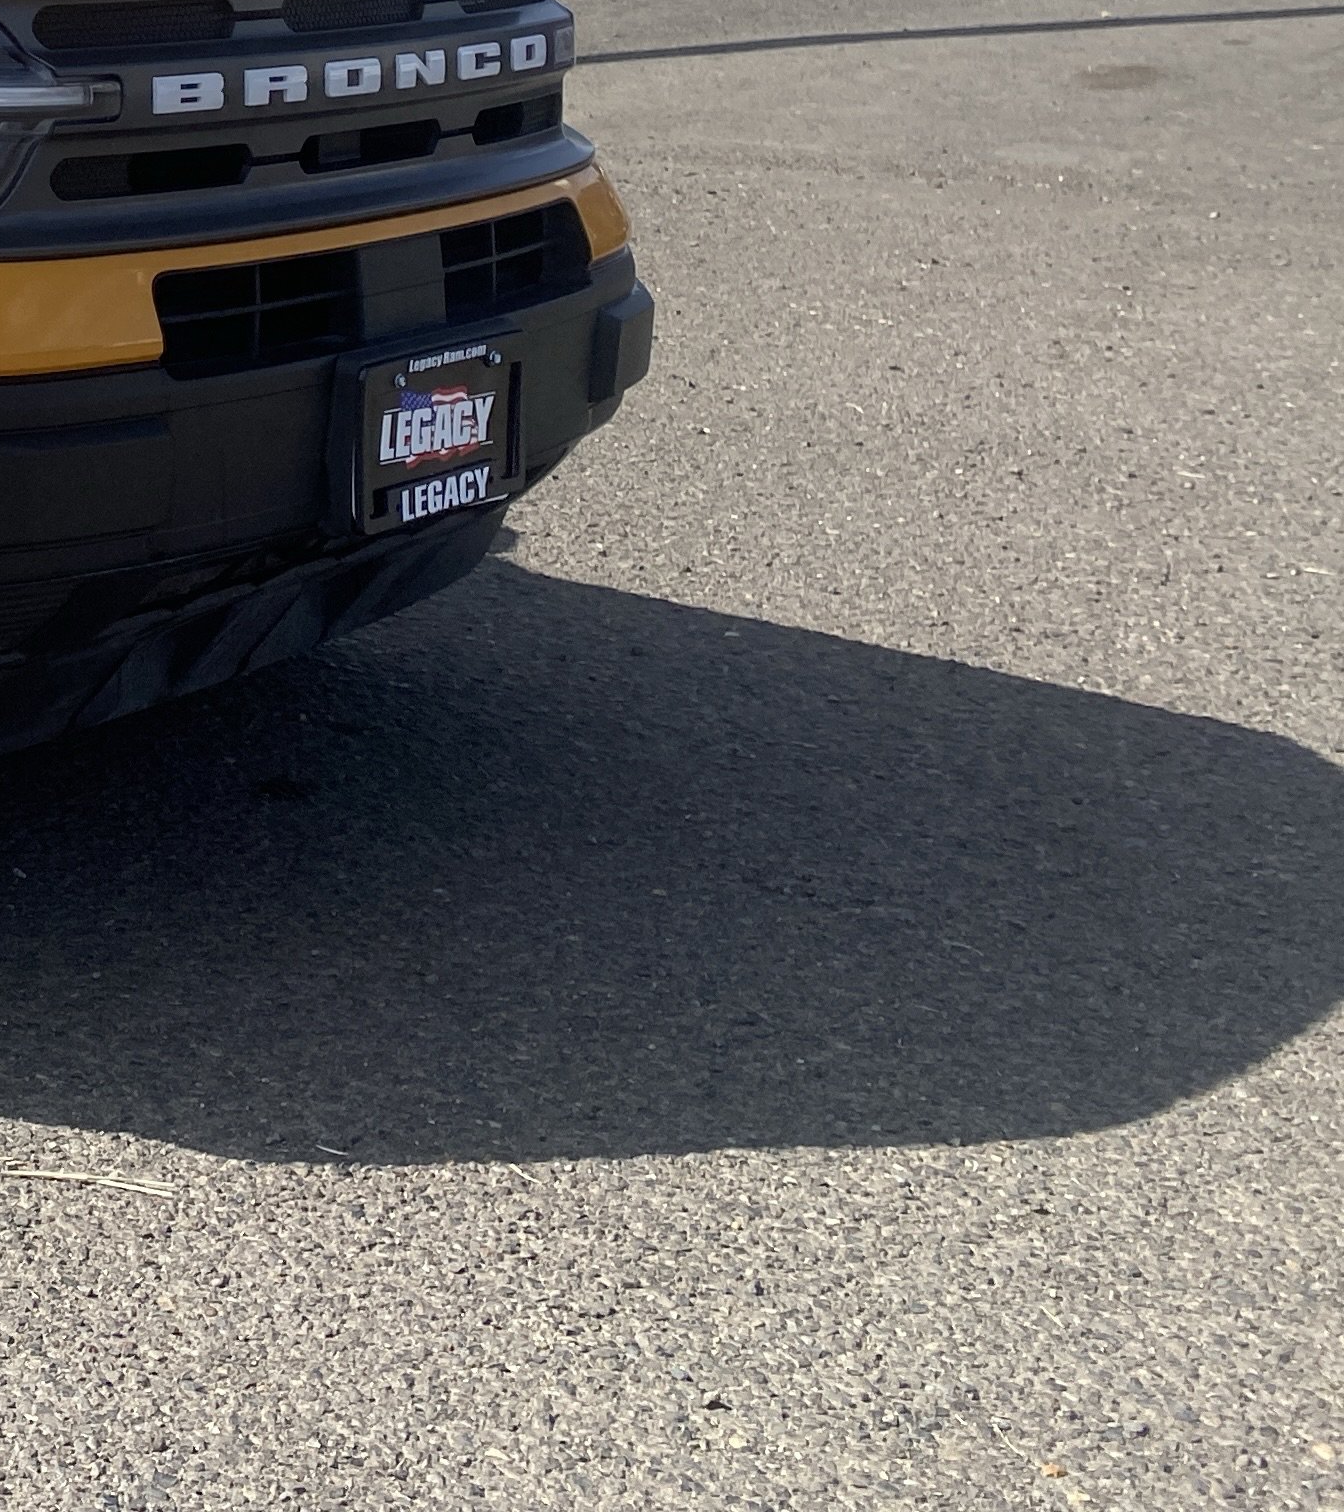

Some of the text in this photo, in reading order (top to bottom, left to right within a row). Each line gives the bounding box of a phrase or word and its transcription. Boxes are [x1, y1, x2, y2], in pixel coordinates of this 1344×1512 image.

[151, 34, 546, 115] BRONCO
[379, 395, 496, 462] LEGACY
[401, 466, 490, 522] LEGACY
